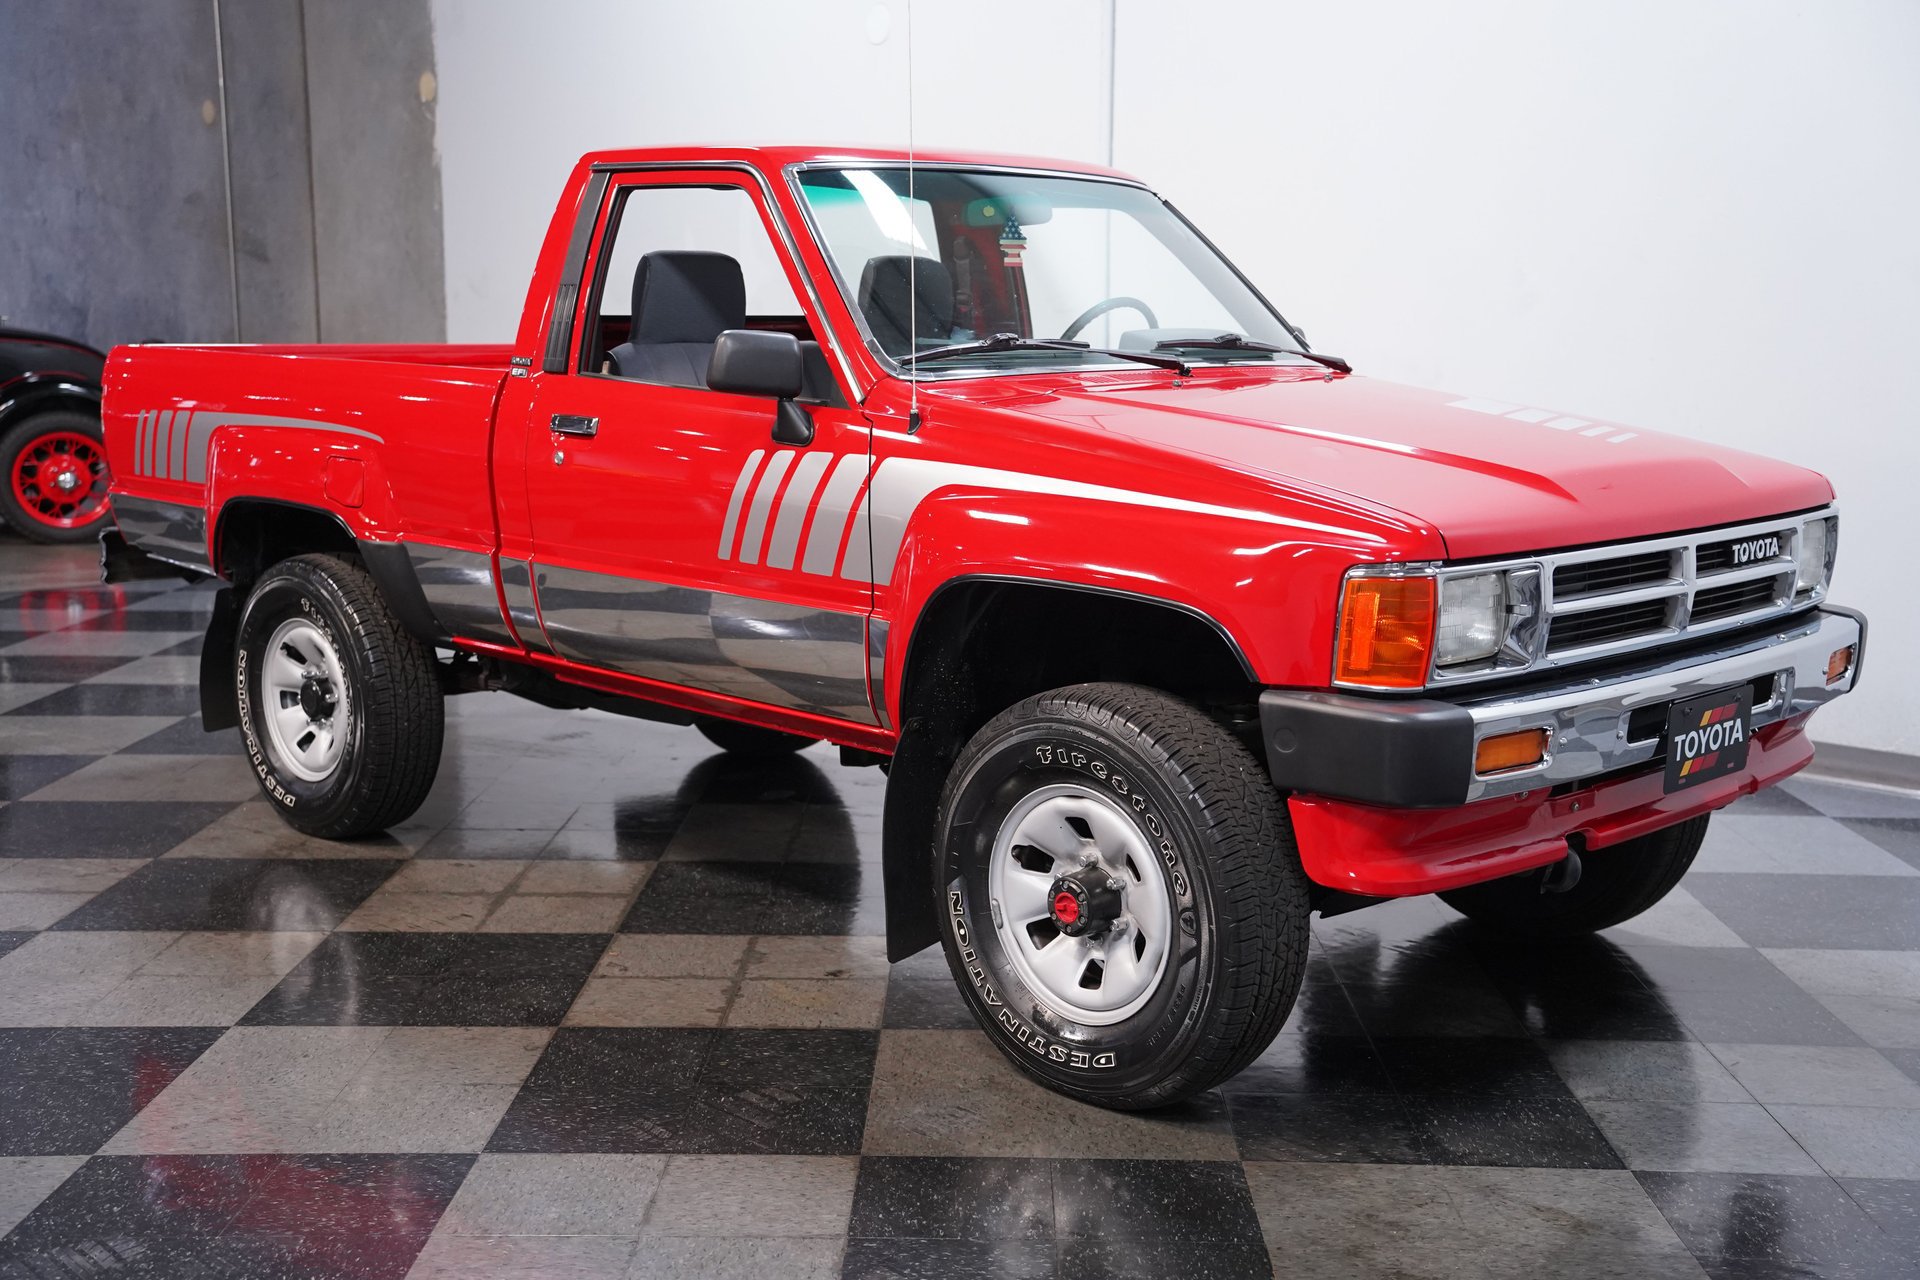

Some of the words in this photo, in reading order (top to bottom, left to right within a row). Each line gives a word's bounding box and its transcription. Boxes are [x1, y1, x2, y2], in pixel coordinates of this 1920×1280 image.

[1732, 537, 1779, 564] TOYOTA
[236, 649, 296, 808] DESTINATION
[1674, 718, 1743, 761] TOYOTA
[1036, 744, 1187, 897] Firestone
[949, 890, 1115, 1069] DESTINATION
